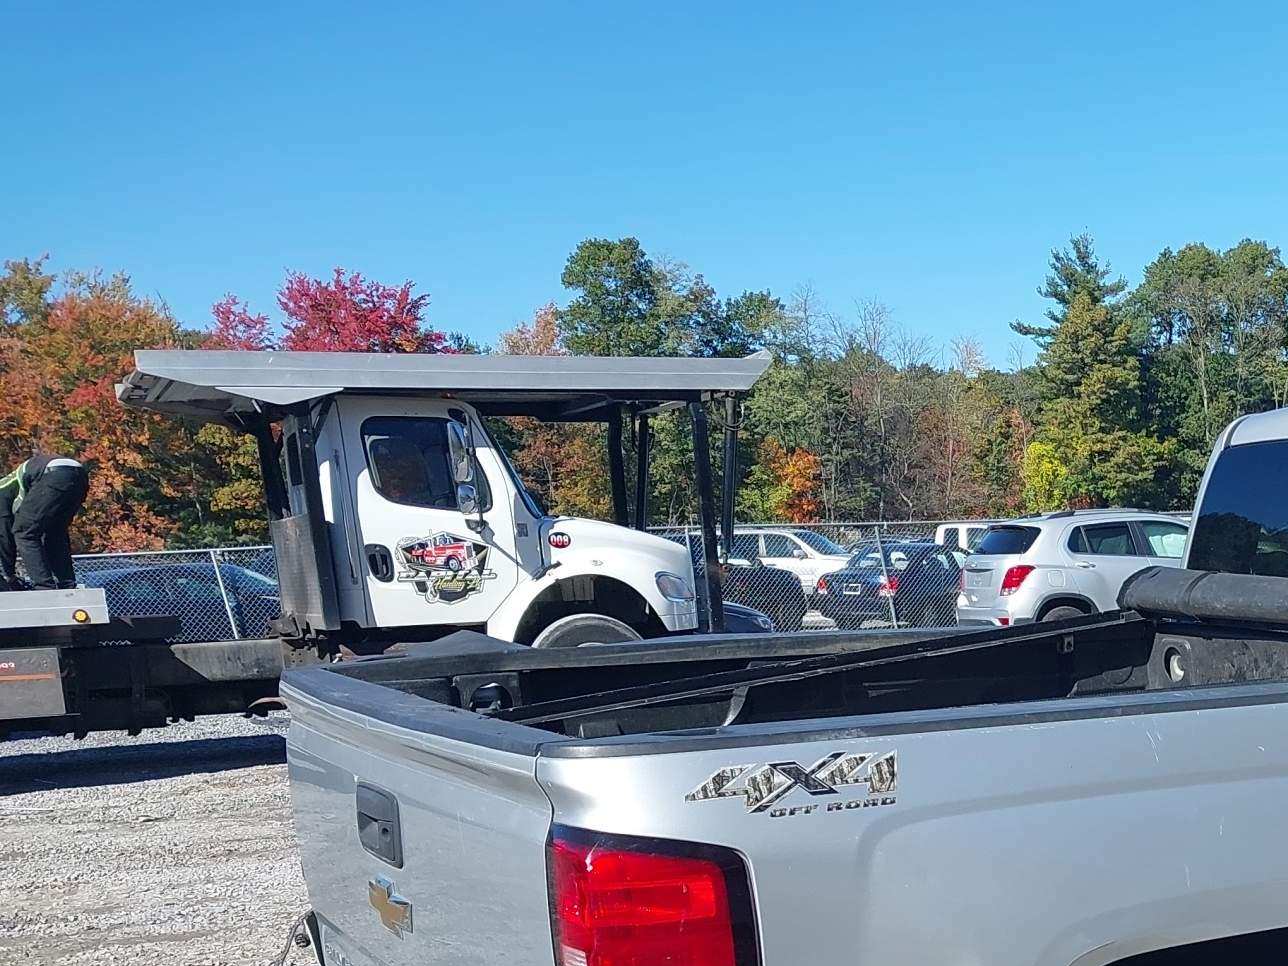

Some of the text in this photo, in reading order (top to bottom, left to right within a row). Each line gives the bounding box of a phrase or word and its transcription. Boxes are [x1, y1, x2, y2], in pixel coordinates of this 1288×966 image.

[550, 534, 569, 545] 008
[769, 796, 897, 818] OFF ROAD
